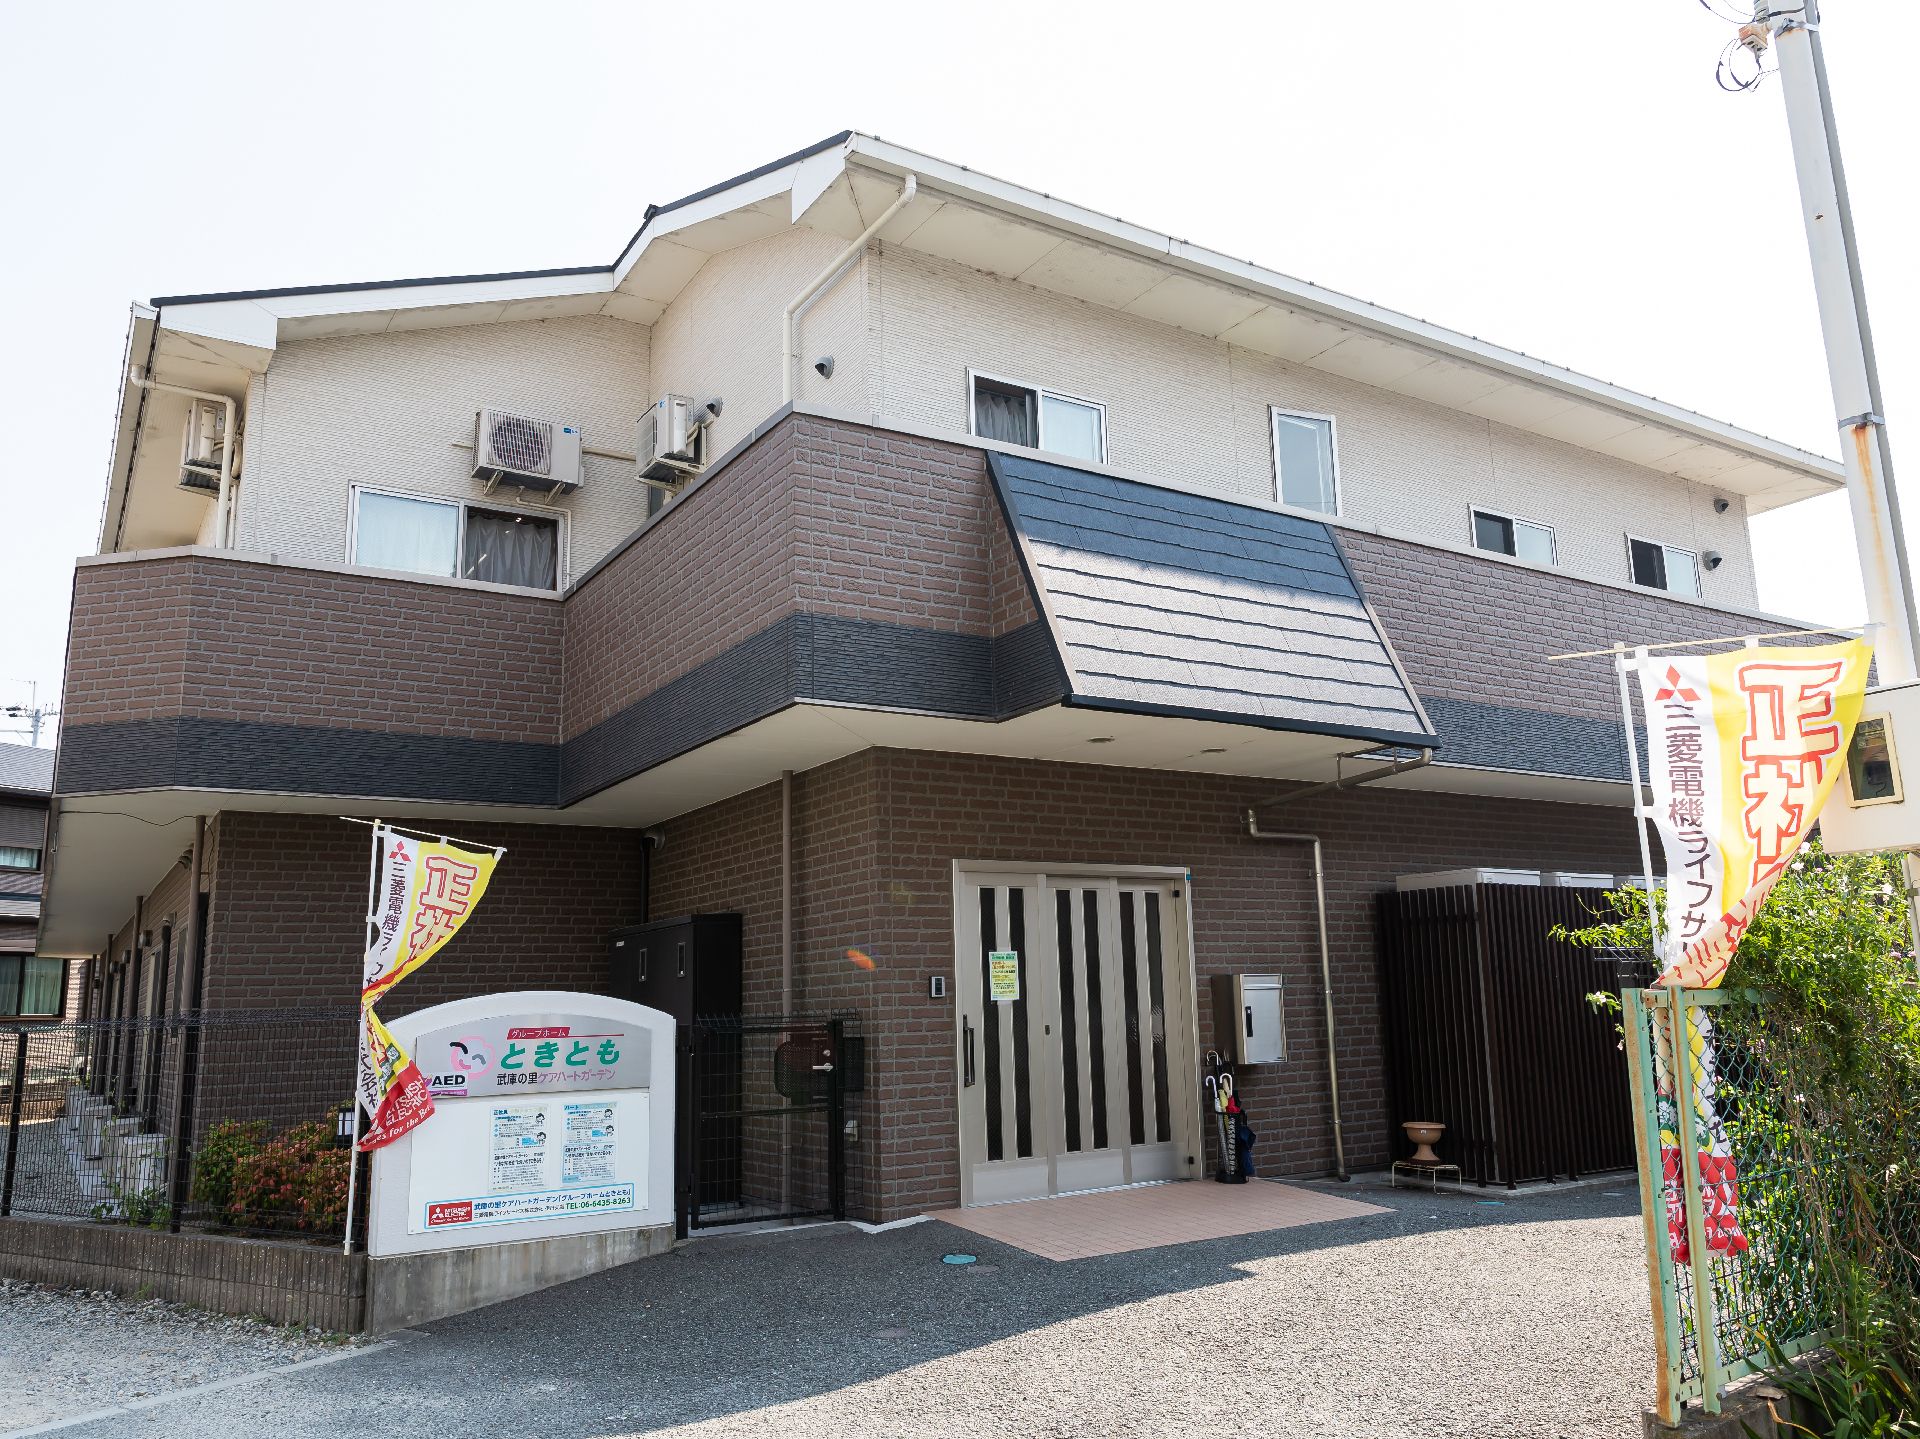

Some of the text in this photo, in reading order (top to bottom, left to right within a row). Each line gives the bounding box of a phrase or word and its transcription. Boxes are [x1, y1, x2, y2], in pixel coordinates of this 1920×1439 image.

[510, 1028, 567, 1038] グループホーム
[500, 1039, 620, 1070] ときとも
[432, 1075, 466, 1086] AED
[496, 1068, 616, 1086] 武庫の里ケアハートガーデン
